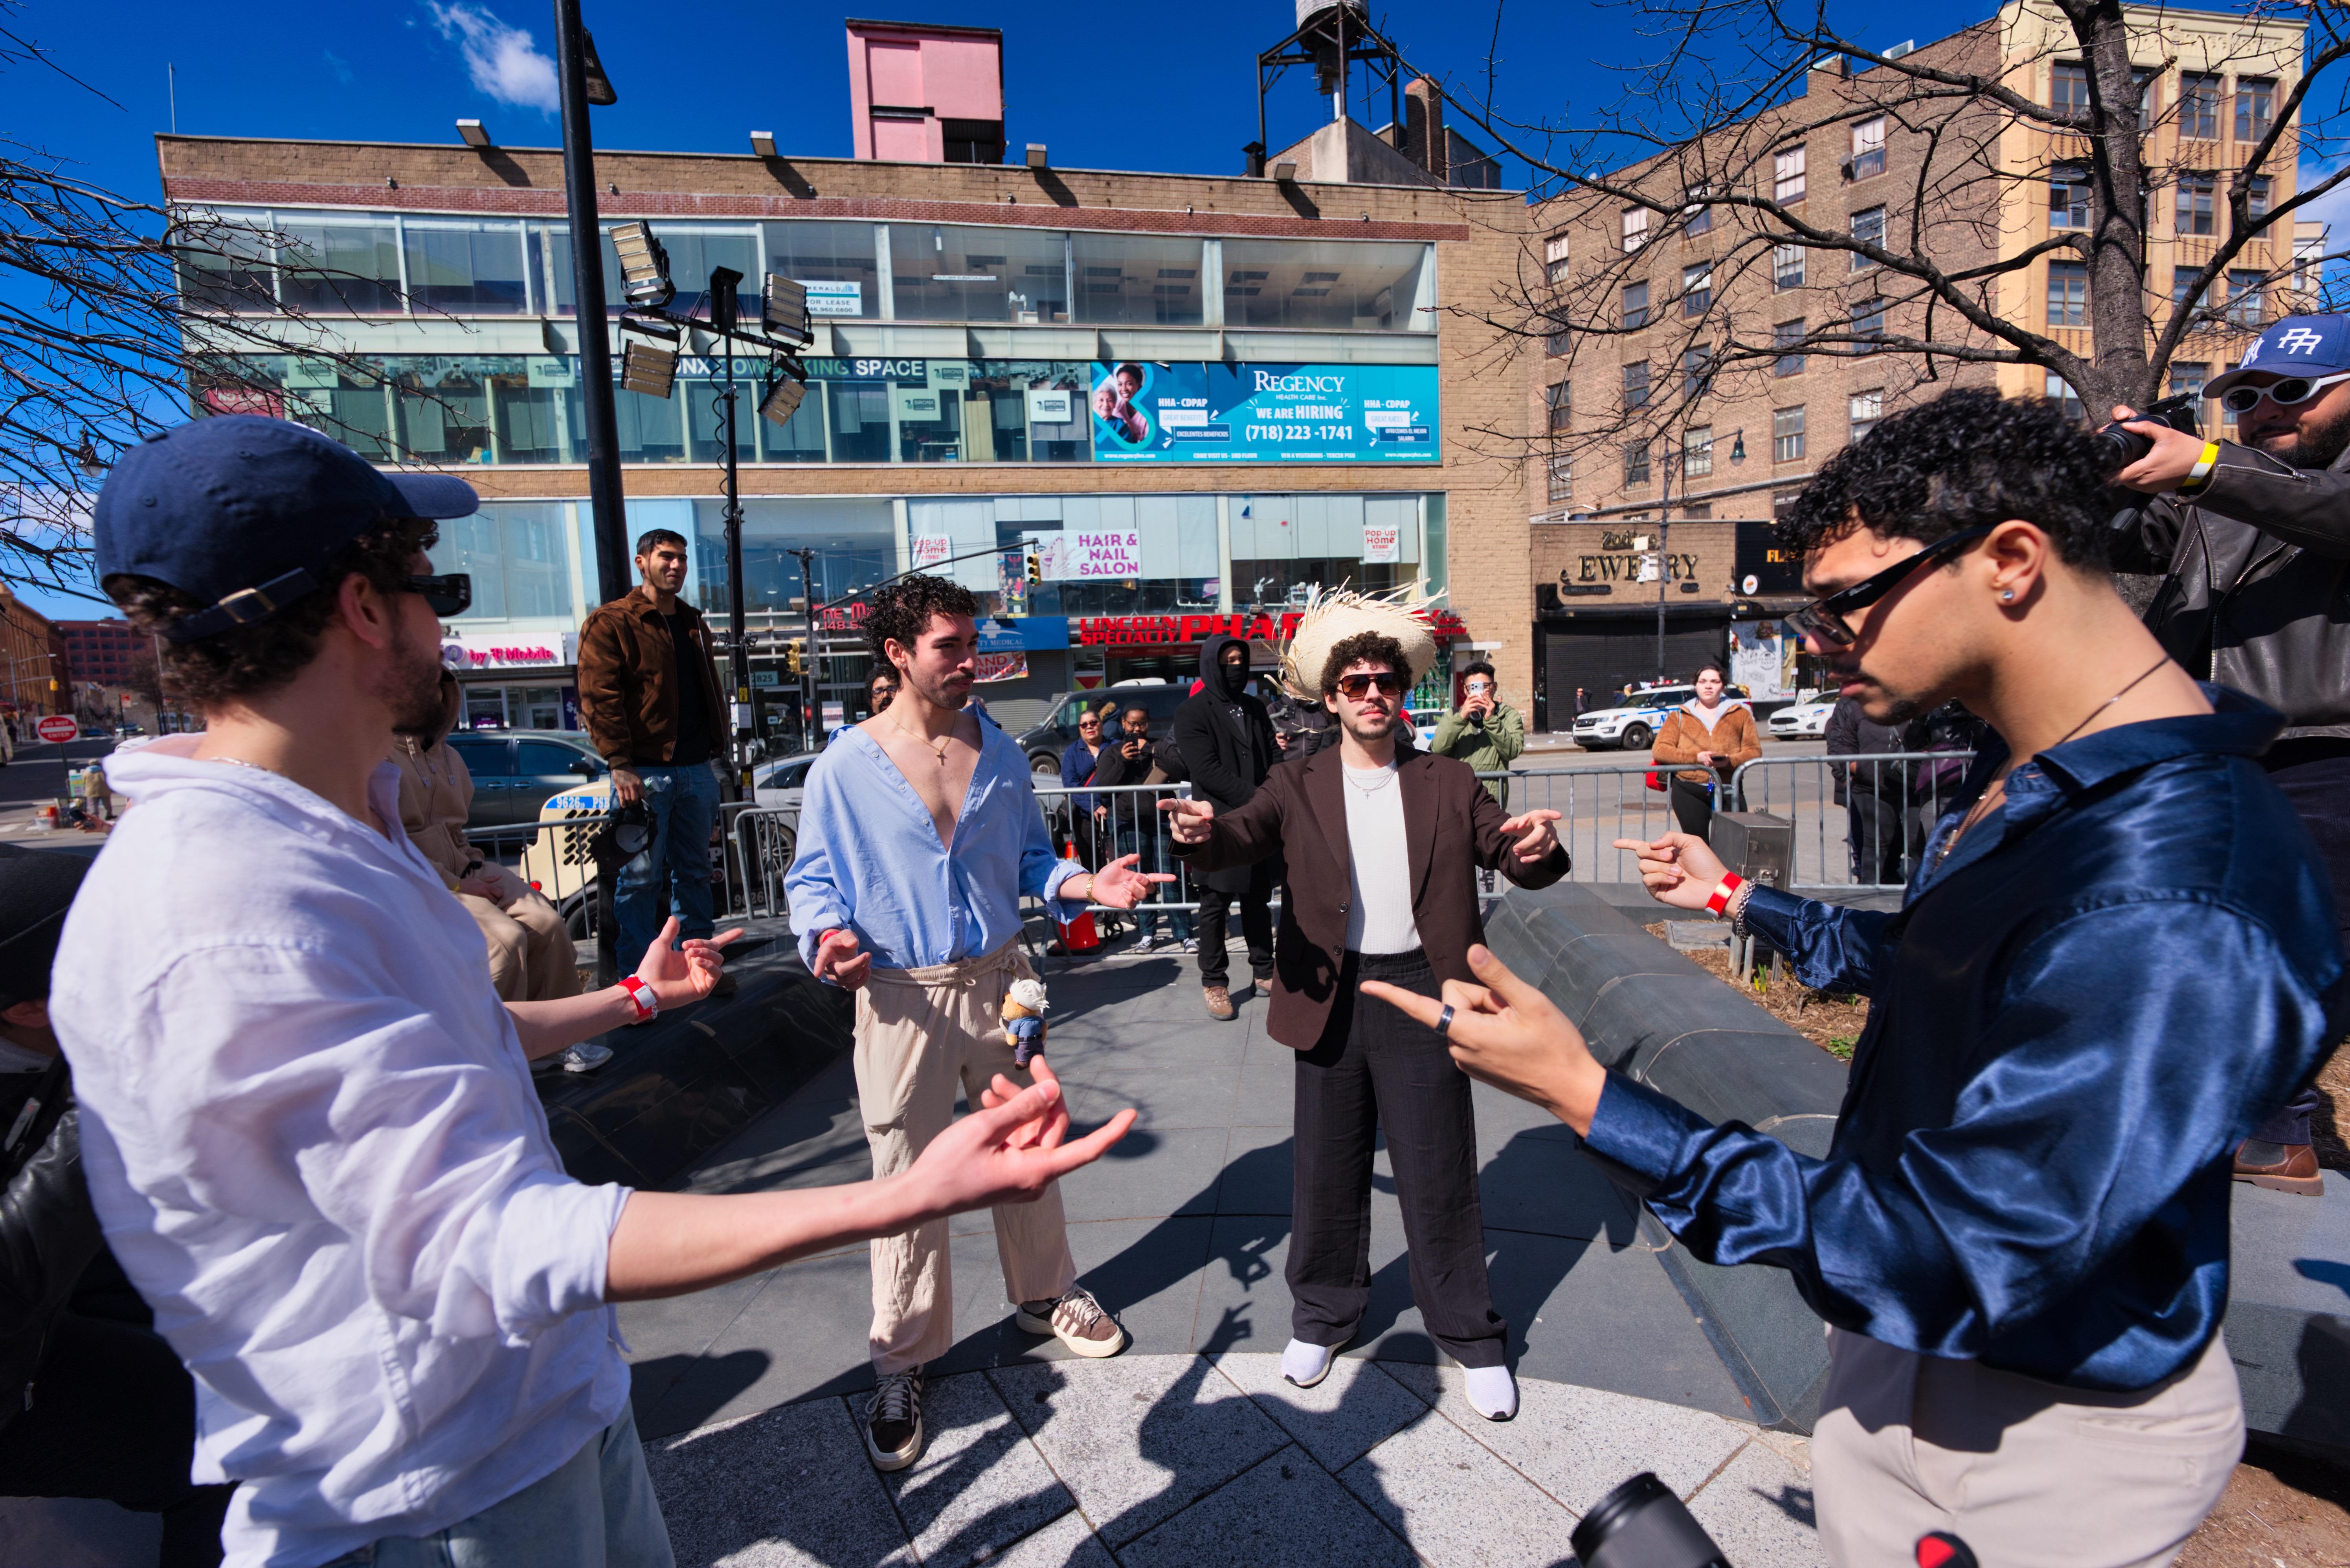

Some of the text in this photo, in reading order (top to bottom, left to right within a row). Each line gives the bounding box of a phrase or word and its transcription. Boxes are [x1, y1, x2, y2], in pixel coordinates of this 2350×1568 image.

[665, 312, 690, 323] NYPD
[755, 336, 778, 347] NYPD
[716, 358, 850, 376] COWKING
[856, 360, 924, 376] SPACE
[1254, 371, 1345, 392] REGENCY
[1158, 398, 1176, 406] HHA
[1181, 398, 1208, 407] CDPAP
[1364, 400, 1381, 408] HHA
[1386, 400, 1410, 408] CDPAP
[1256, 405, 1343, 419] WE ARE HIRING
[1246, 424, 1283, 442] (718)
[1285, 426, 1311, 440] 223
[1079, 534, 1137, 547] HAIR &
[1090, 548, 1129, 561] NAIL
[1081, 562, 1138, 575] SALON
[1560, 553, 1698, 584] EWERY
[824, 621, 846, 630] 148
[1081, 616, 1177, 631] LINCOLN
[1434, 626, 1467, 635] WITHIN
[1081, 630, 1177, 646] SPECIALTY
[469, 649, 487, 665] by
[505, 646, 553, 661] Mobile
[977, 656, 1007, 666] AND
[976, 666, 1015, 676] NING
[556, 797, 580, 808] 9626
